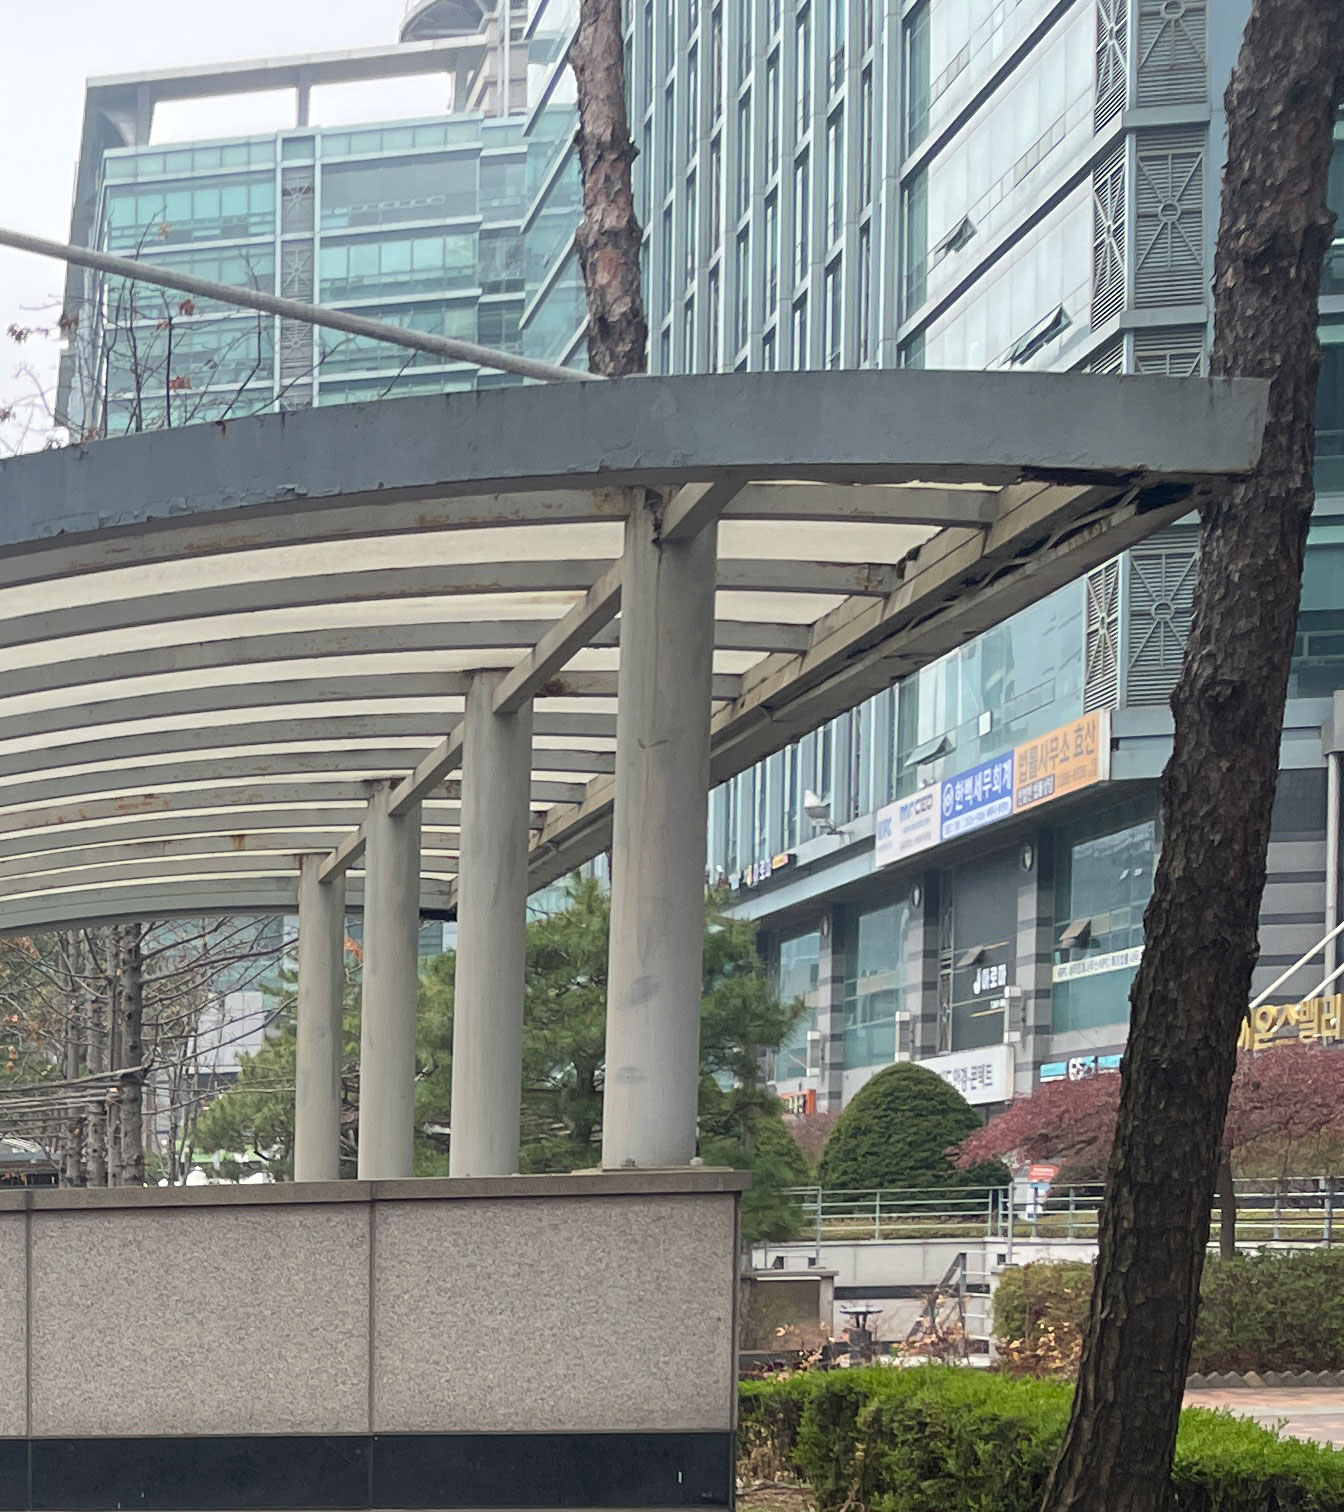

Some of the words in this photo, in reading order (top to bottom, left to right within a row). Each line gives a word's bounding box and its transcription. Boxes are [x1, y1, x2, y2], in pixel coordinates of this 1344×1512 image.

[1018, 732, 1070, 784] 법률사무소
[1073, 719, 1096, 758] 효산
[954, 758, 1012, 811] 한백세무회계
